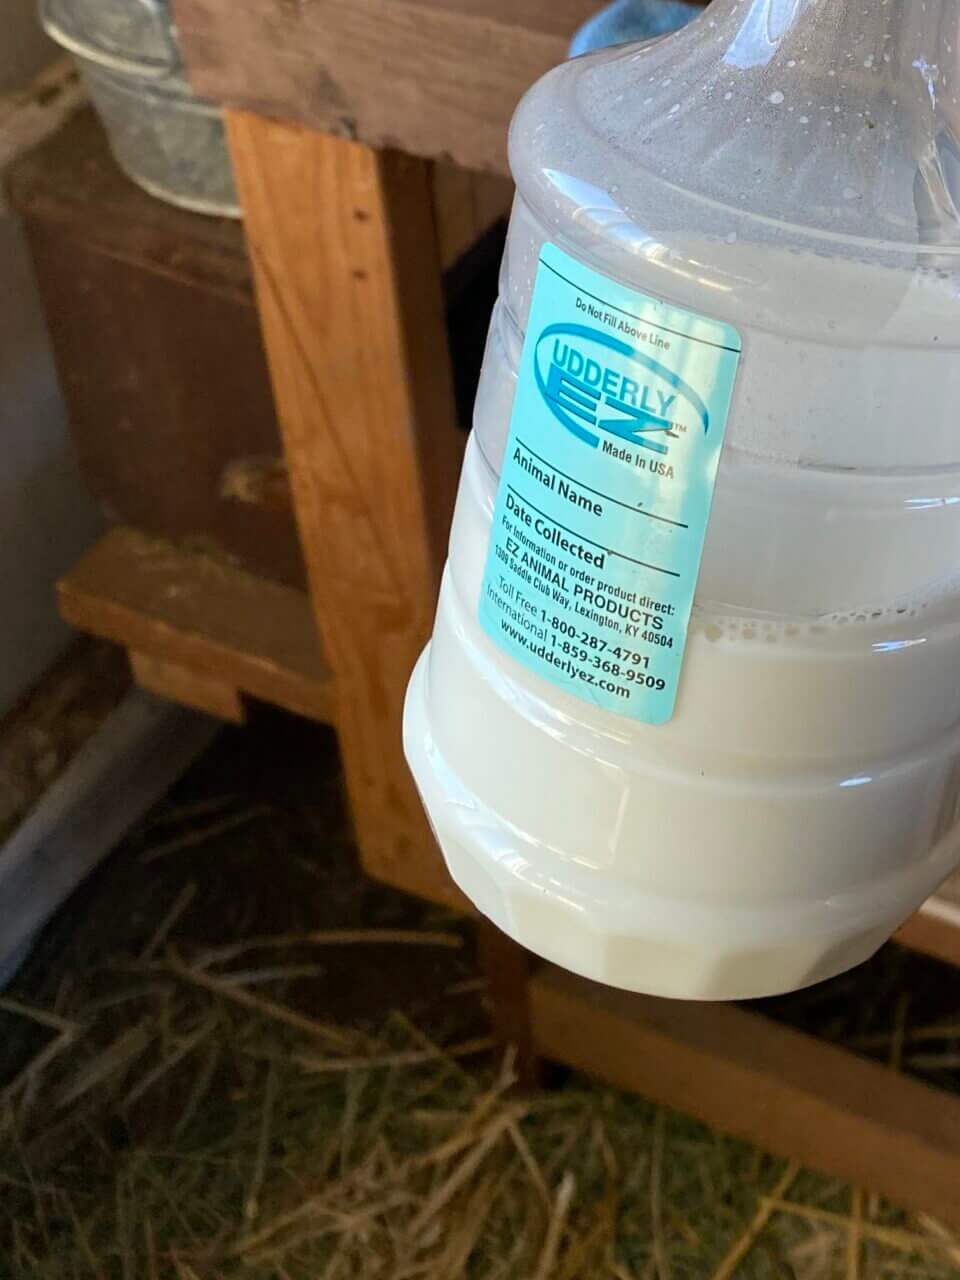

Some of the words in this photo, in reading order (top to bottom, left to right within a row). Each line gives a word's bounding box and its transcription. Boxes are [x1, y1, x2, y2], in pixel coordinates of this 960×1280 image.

[576, 297, 586, 312] Do
[587, 305, 602, 320] Not
[603, 312, 617, 328] Fill
[617, 320, 648, 342] Above
[649, 334, 671, 351] Line
[545, 361, 673, 456] EZ
[552, 338, 677, 417] UDDERLY
[513, 447, 555, 490] Animal
[558, 480, 603, 517] Name
[602, 440, 632, 464] Made
[635, 455, 646, 470] In
[650, 460, 675, 480] USA
[502, 514, 513, 531] For
[558, 561, 568, 573] or
[570, 565, 595, 587] order
[597, 580, 637, 604] product
[639, 596, 675, 616] direct:
[506, 493, 532, 527] Date
[535, 519, 605, 569] Collected
[499, 575, 514, 599] Toll
[516, 591, 537, 616] Free
[541, 610, 650, 668] 1-800-287-4791
[506, 537, 520, 558] EZ
[521, 552, 569, 593] ANIMAL
[574, 584, 664, 630] PRODUCTS
[509, 558, 532, 584] Saddle
[533, 578, 551, 597] Club
[552, 586, 572, 611] Way,
[575, 601, 622, 633] Lexington,
[625, 624, 640, 638] KY
[641, 630, 673, 649] 40504
[487, 584, 548, 642] International
[551, 634, 666, 691] 1-859-368-9509
[501, 619, 630, 699] www.udderlyez.com
